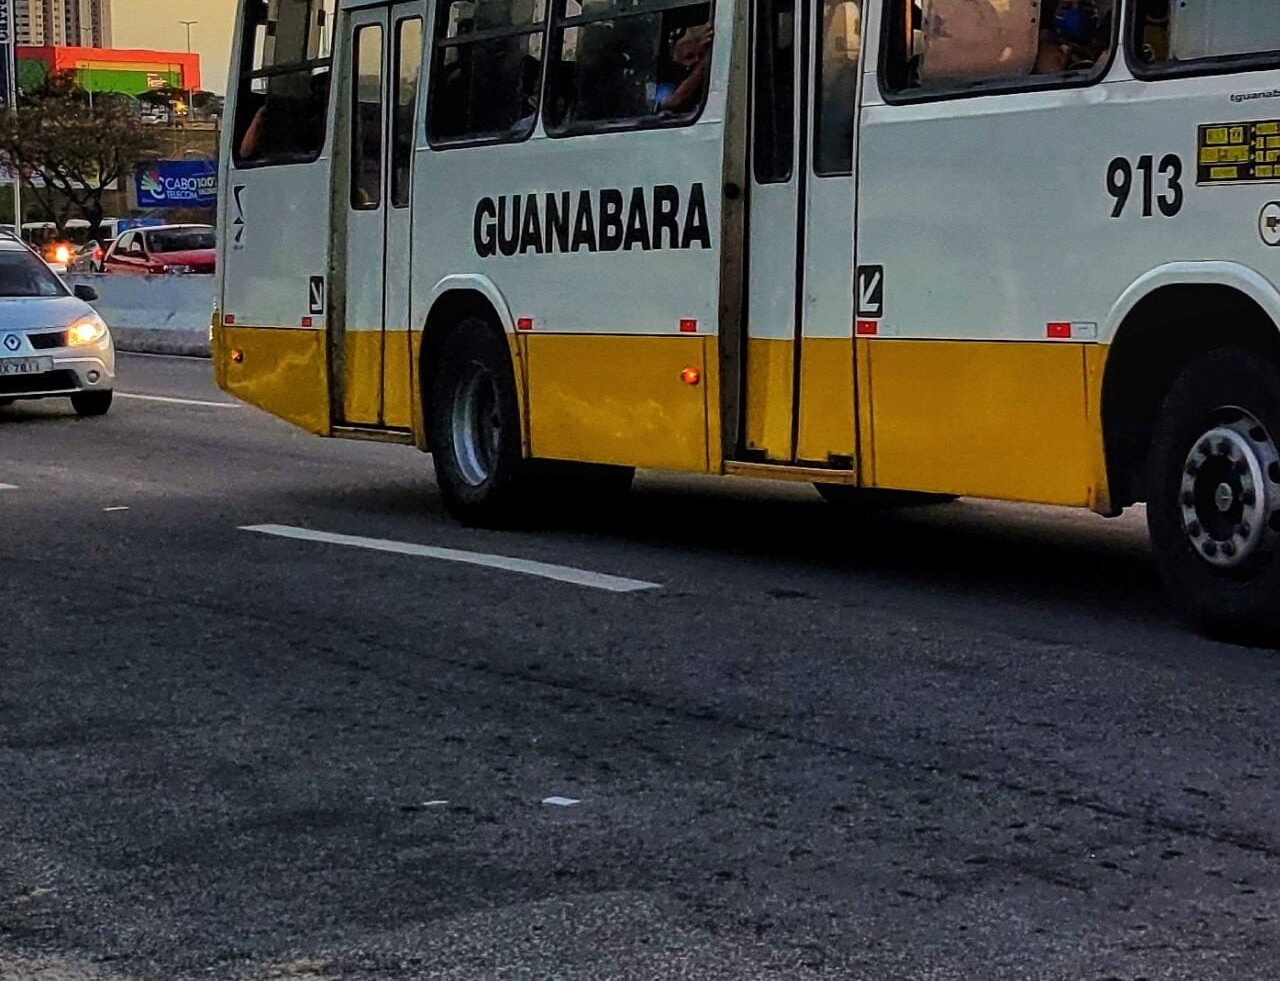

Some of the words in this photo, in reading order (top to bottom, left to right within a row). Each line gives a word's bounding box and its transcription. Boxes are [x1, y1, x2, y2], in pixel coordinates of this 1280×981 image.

[165, 178, 197, 191] CABO
[1106, 153, 1183, 218] 913
[474, 182, 711, 258] GUANABARA
